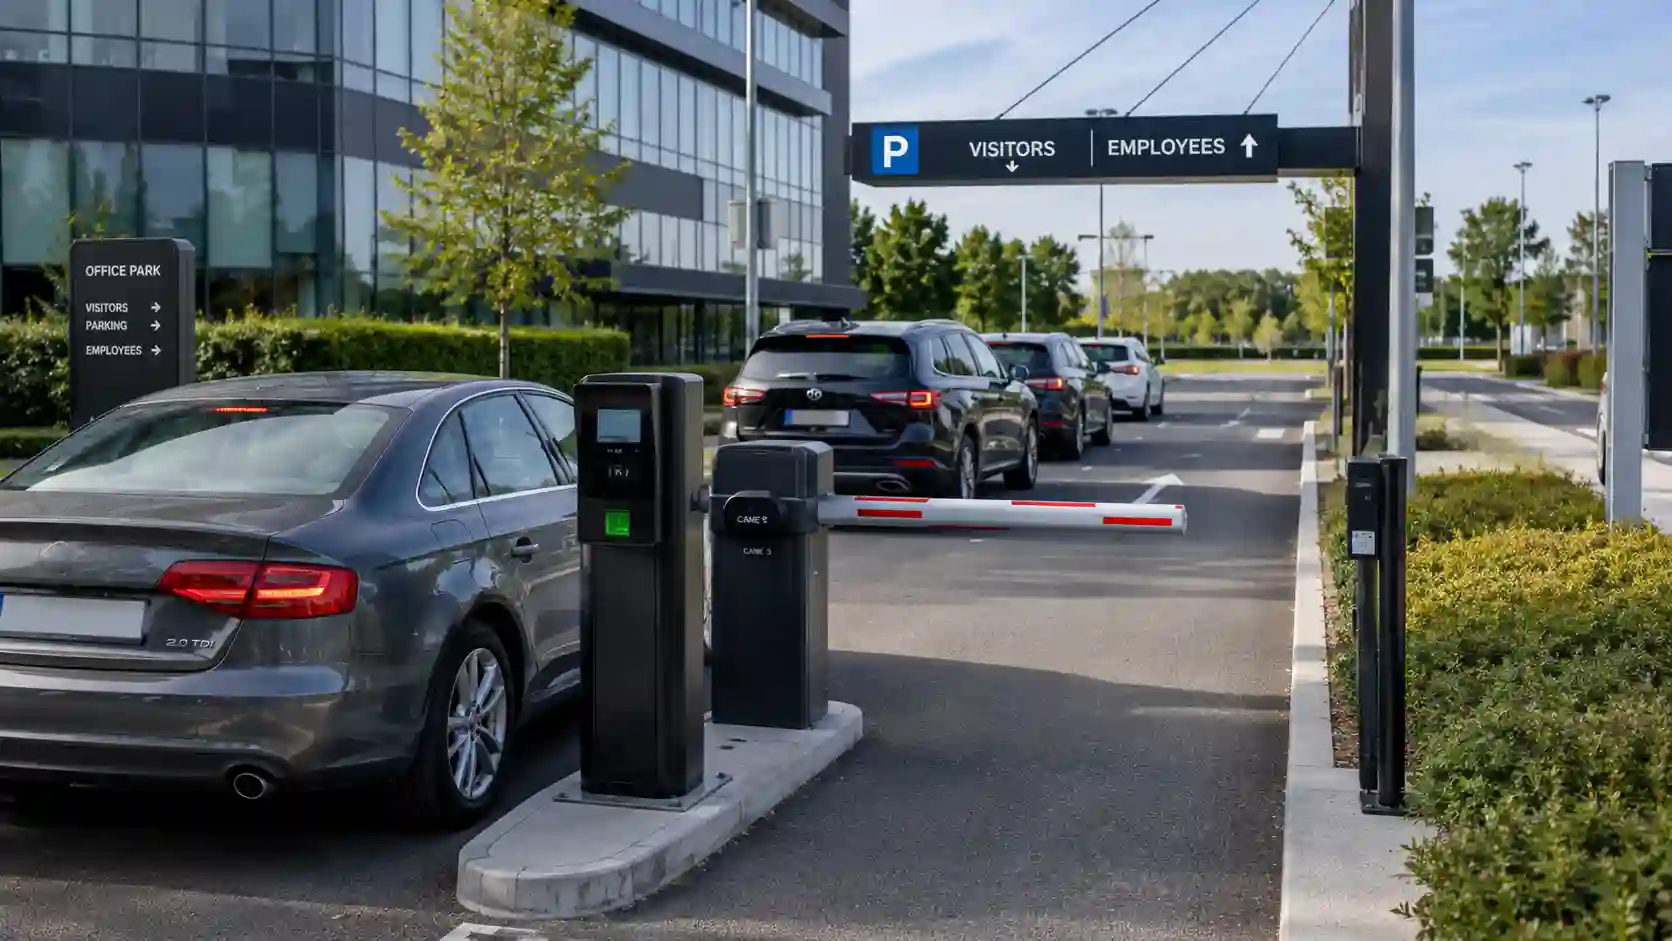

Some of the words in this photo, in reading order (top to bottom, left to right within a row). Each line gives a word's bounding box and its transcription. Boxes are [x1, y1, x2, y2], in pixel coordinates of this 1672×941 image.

[883, 135, 909, 168] P
[969, 140, 1056, 157] VISITORS
[1107, 138, 1226, 156] EMPLOYEES
[85, 265, 126, 277] OFFICE
[129, 264, 161, 276] PARK
[85, 302, 128, 313] VISITORS
[85, 320, 127, 331] PARKING
[85, 345, 142, 356] EMPLOYEES
[191, 639, 216, 648] TDI
